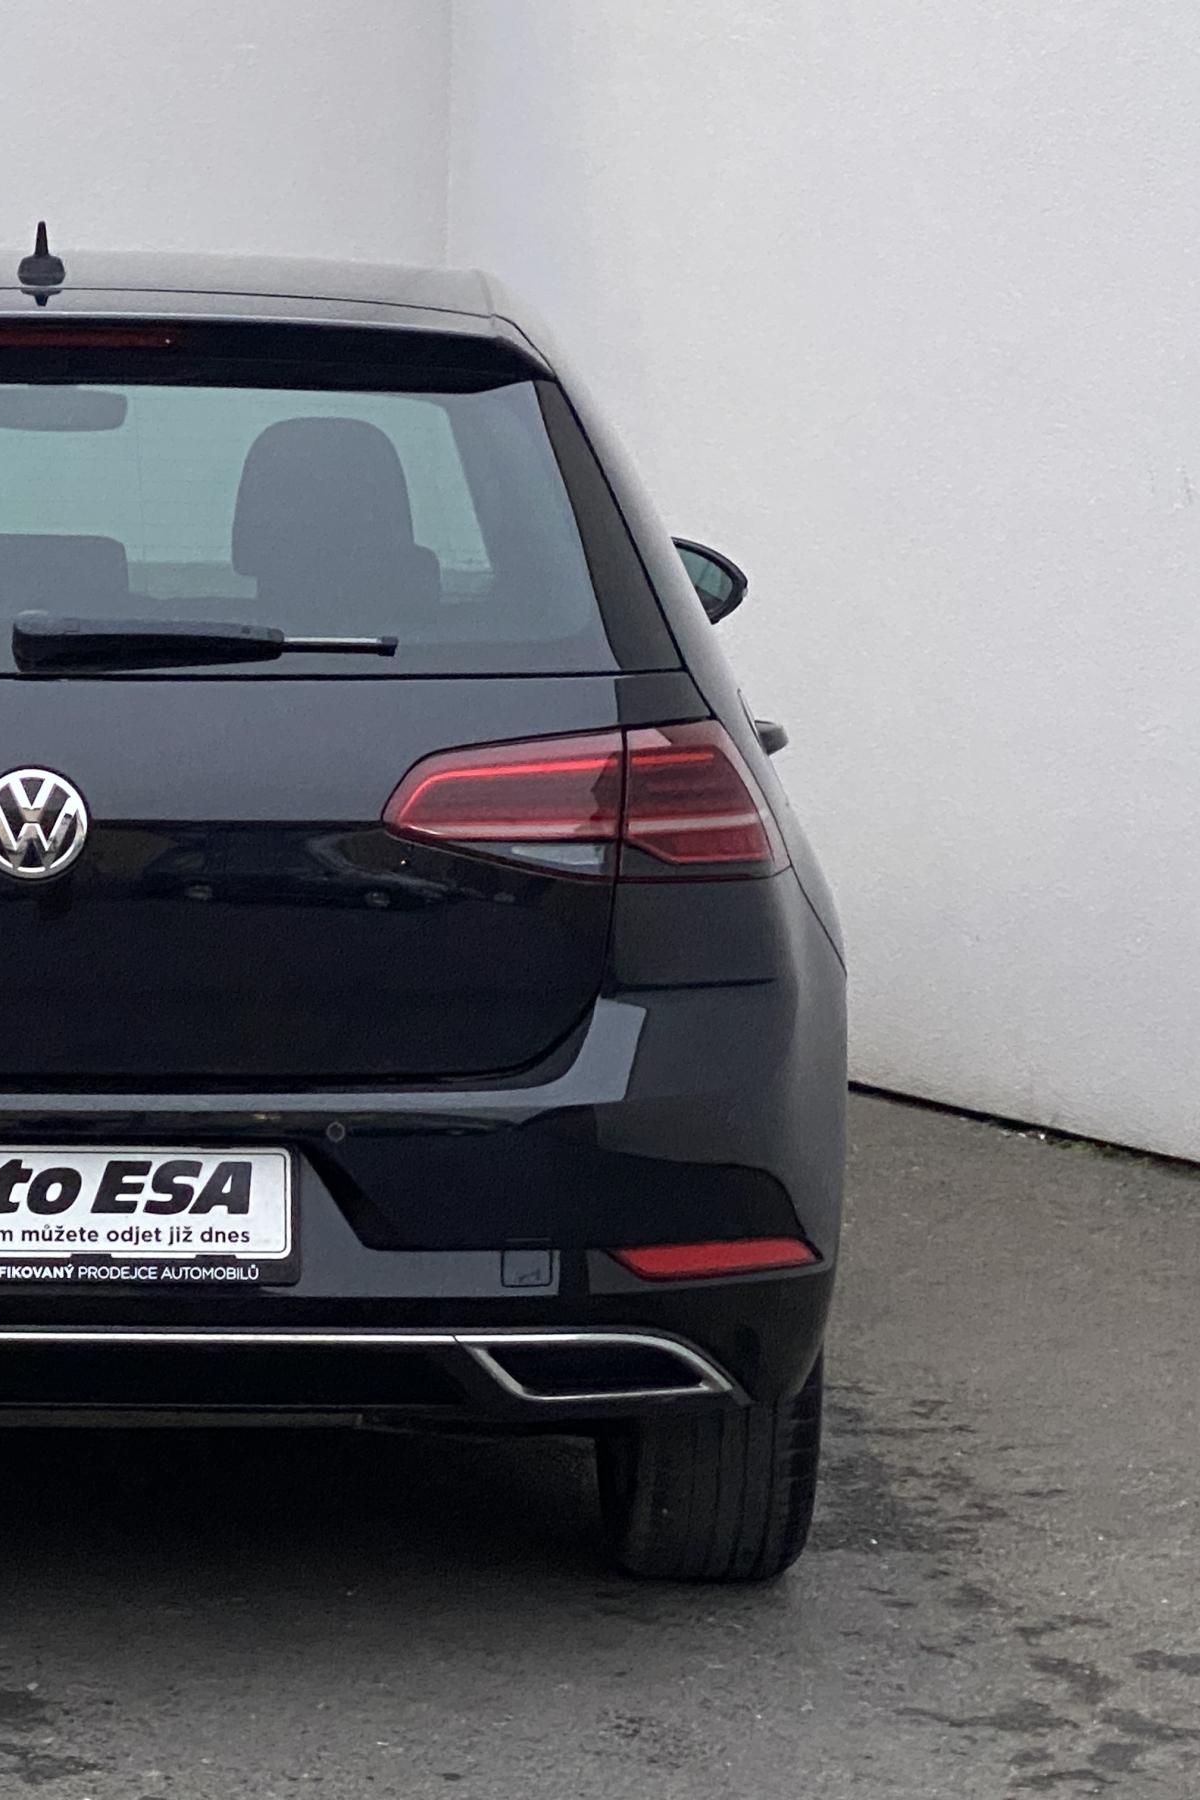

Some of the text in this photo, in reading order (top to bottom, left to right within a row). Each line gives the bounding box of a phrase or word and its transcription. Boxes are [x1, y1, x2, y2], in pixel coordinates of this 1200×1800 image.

[90, 1160, 252, 1215] ESA
[21, 1223, 99, 1243] můžete
[106, 1225, 162, 1247] odjet
[167, 1225, 193, 1247] již
[200, 1226, 250, 1243] dnes
[78, 1266, 158, 1280] PRODEJCE
[161, 1264, 260, 1280] AUTOMOBILŮ
